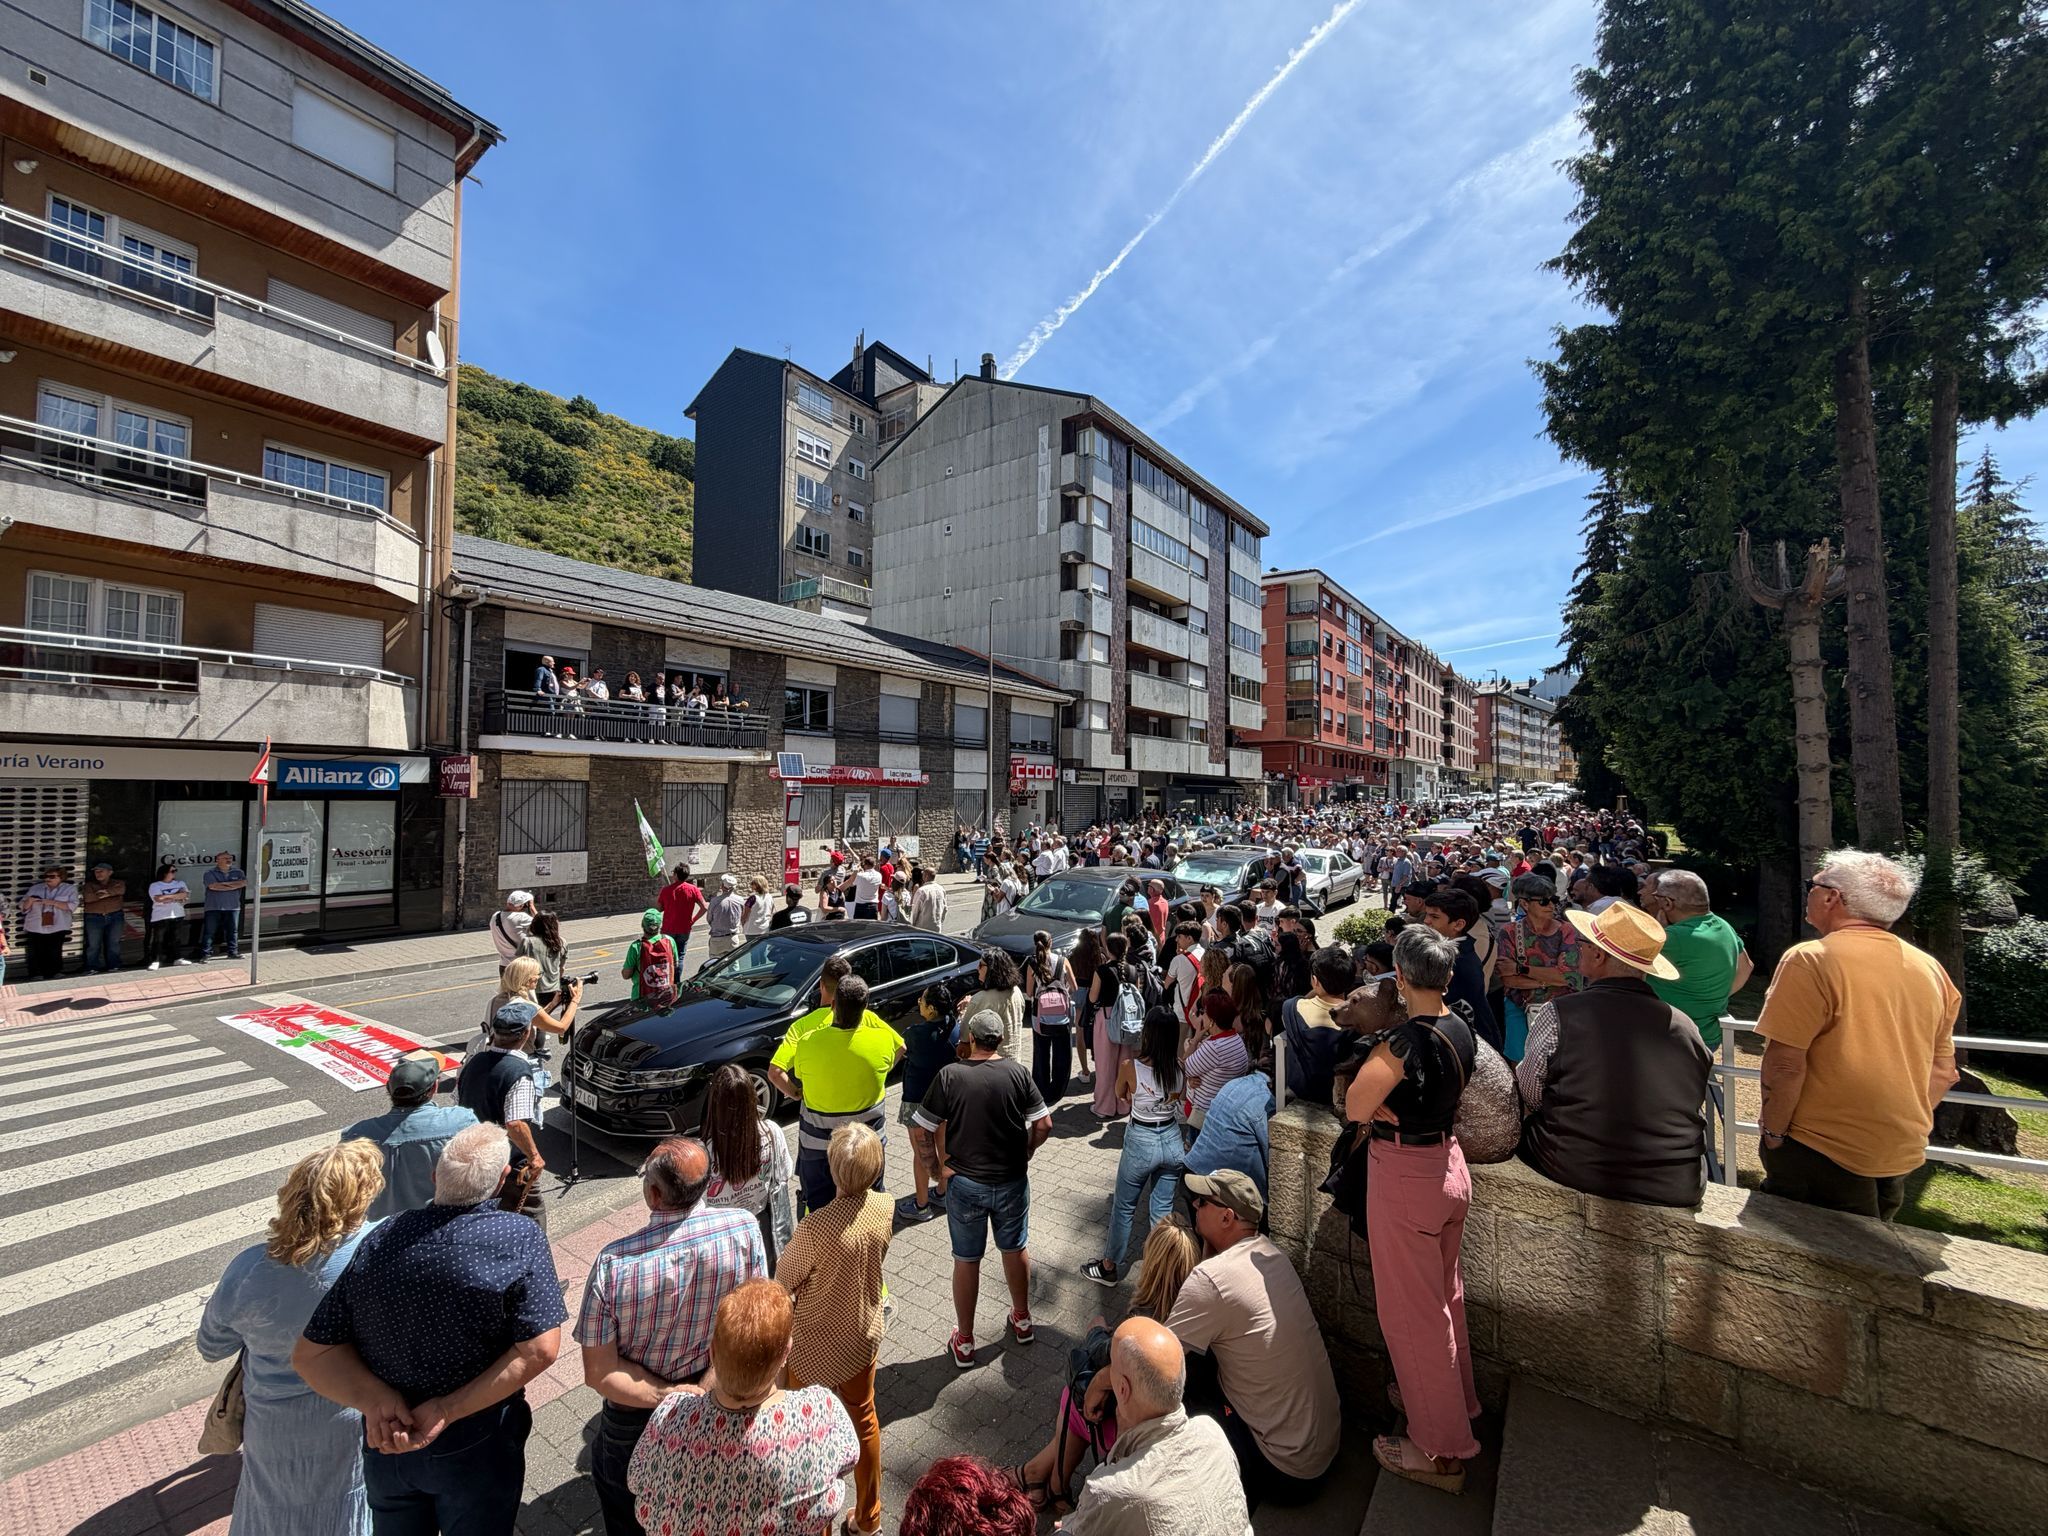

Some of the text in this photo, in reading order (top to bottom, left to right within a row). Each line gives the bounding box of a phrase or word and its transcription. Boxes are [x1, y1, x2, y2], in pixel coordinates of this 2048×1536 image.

[0, 753, 104, 770] ría Verano
[441, 758, 471, 775] Gestoría
[284, 766, 363, 784] Allianz
[810, 766, 845, 775] Comarcal
[1016, 764, 1053, 779] CCOO
[286, 845, 301, 854] HACEN
[332, 845, 392, 858] Asesoría
[160, 853, 237, 866] Gestoa
[272, 857, 309, 867] DECLARACIONES
[336, 859, 356, 867] Fiscal
[276, 870, 304, 880] DE LA RENTA
[730, 1182, 763, 1201] AMERICAN
